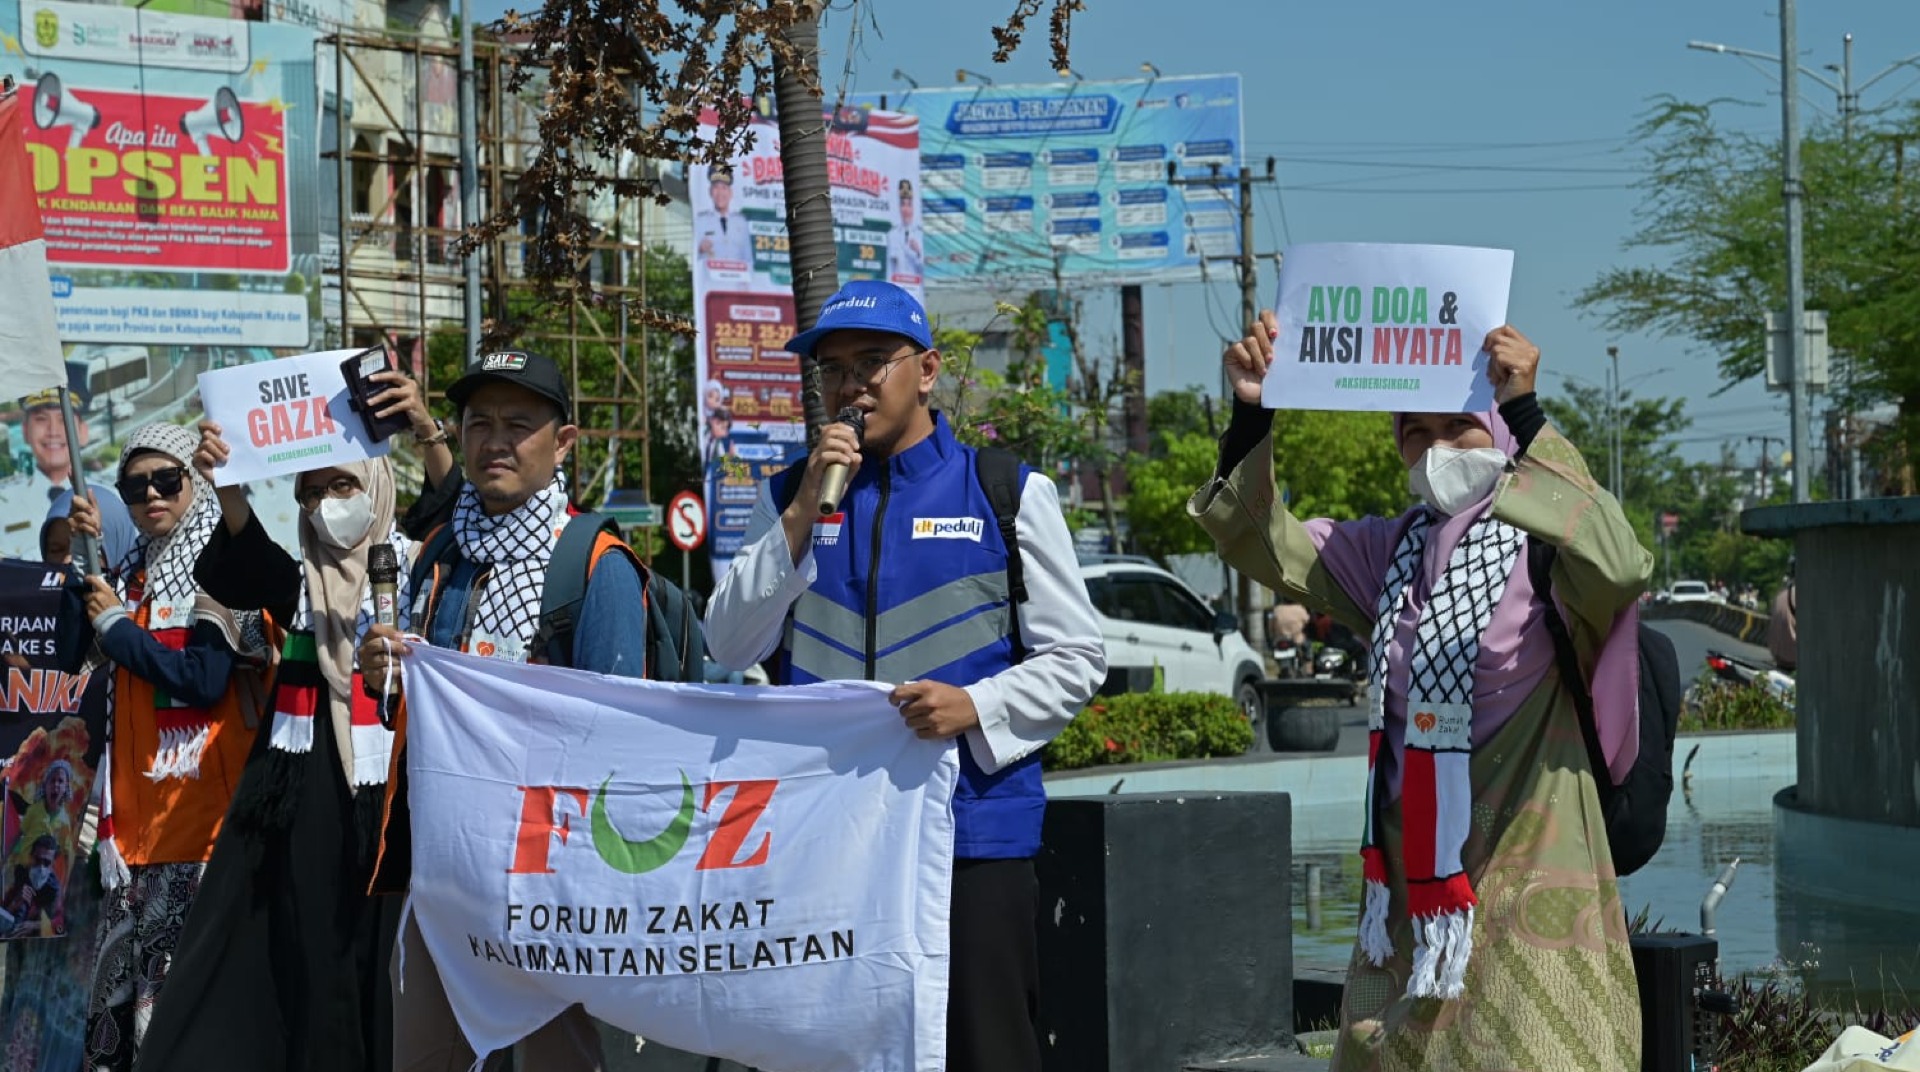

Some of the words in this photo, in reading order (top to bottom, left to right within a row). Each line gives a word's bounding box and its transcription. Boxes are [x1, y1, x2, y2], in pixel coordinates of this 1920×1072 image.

[105, 121, 146, 150] Apa
[149, 124, 177, 148] itu
[51, 198, 135, 214] KENDARAAN
[140, 203, 165, 215] DAN
[170, 204, 196, 217] BEA
[201, 206, 238, 219] BALIK
[242, 208, 279, 221] NAMA
[1307, 286, 1361, 323] AYO
[1372, 286, 1427, 324] DOA
[1438, 291, 1458, 325] &
[1298, 327, 1363, 363] AKSI
[1372, 328, 1462, 365] NYATA
[258, 373, 311, 404] SAVE
[247, 396, 336, 448] GAZA
[915, 519, 982, 536] dtpeduli
[0, 617, 56, 635] RJAAN
[19, 640, 40, 655] KE
[45, 640, 56, 656] S
[507, 904, 628, 934] FORUM
[647, 899, 774, 934] ZAKAT
[468, 933, 665, 976] KALIMANTAN
[679, 929, 854, 973] SELATAN
